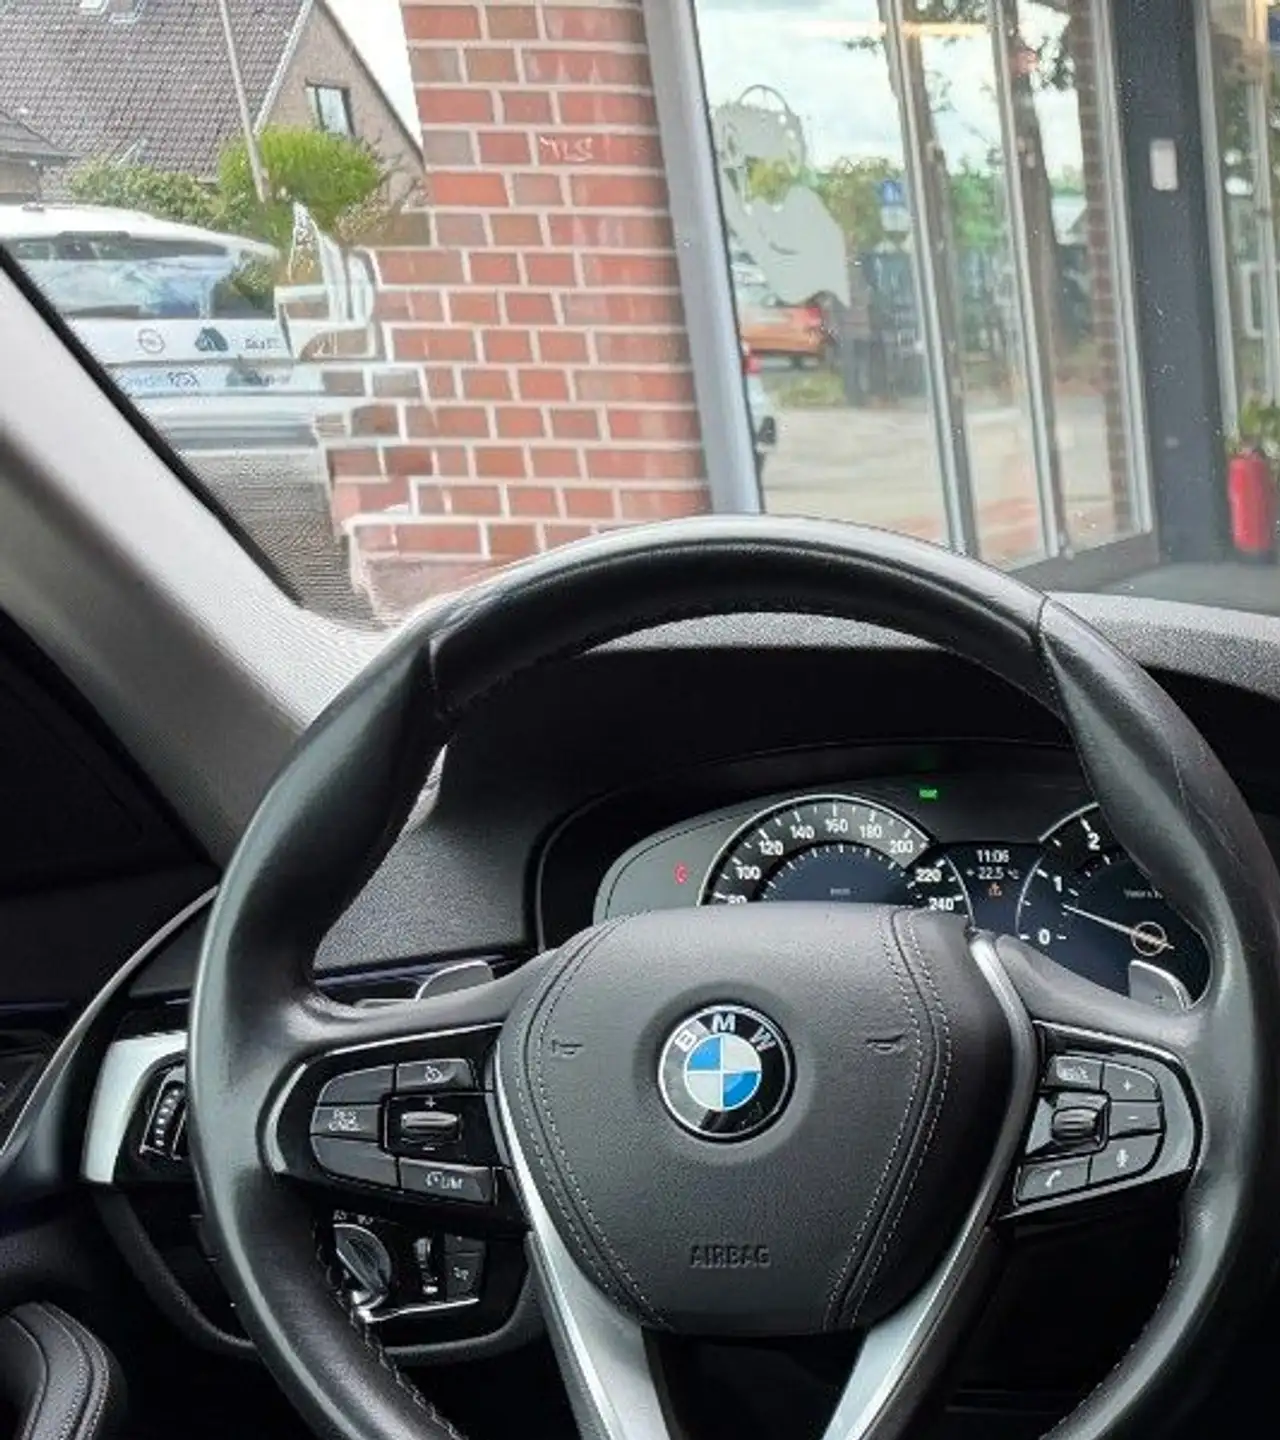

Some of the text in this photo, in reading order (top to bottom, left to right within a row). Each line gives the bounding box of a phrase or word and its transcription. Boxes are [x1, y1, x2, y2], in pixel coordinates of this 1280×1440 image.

[790, 825, 815, 840] 140
[825, 819, 849, 833] 160
[860, 825, 883, 840] 180
[759, 839, 784, 857] 120
[889, 839, 914, 855] 200
[1088, 831, 1101, 851] 2
[976, 849, 1010, 864] 11:06
[737, 866, 762, 881] 100
[915, 867, 943, 883] 220
[978, 866, 1004, 880] 22.5
[1053, 874, 1063, 893] 1
[930, 898, 955, 912] 240
[1038, 927, 1051, 945] 0
[674, 1013, 777, 1053] BMW
[689, 1245, 772, 1270] AIRBAG
